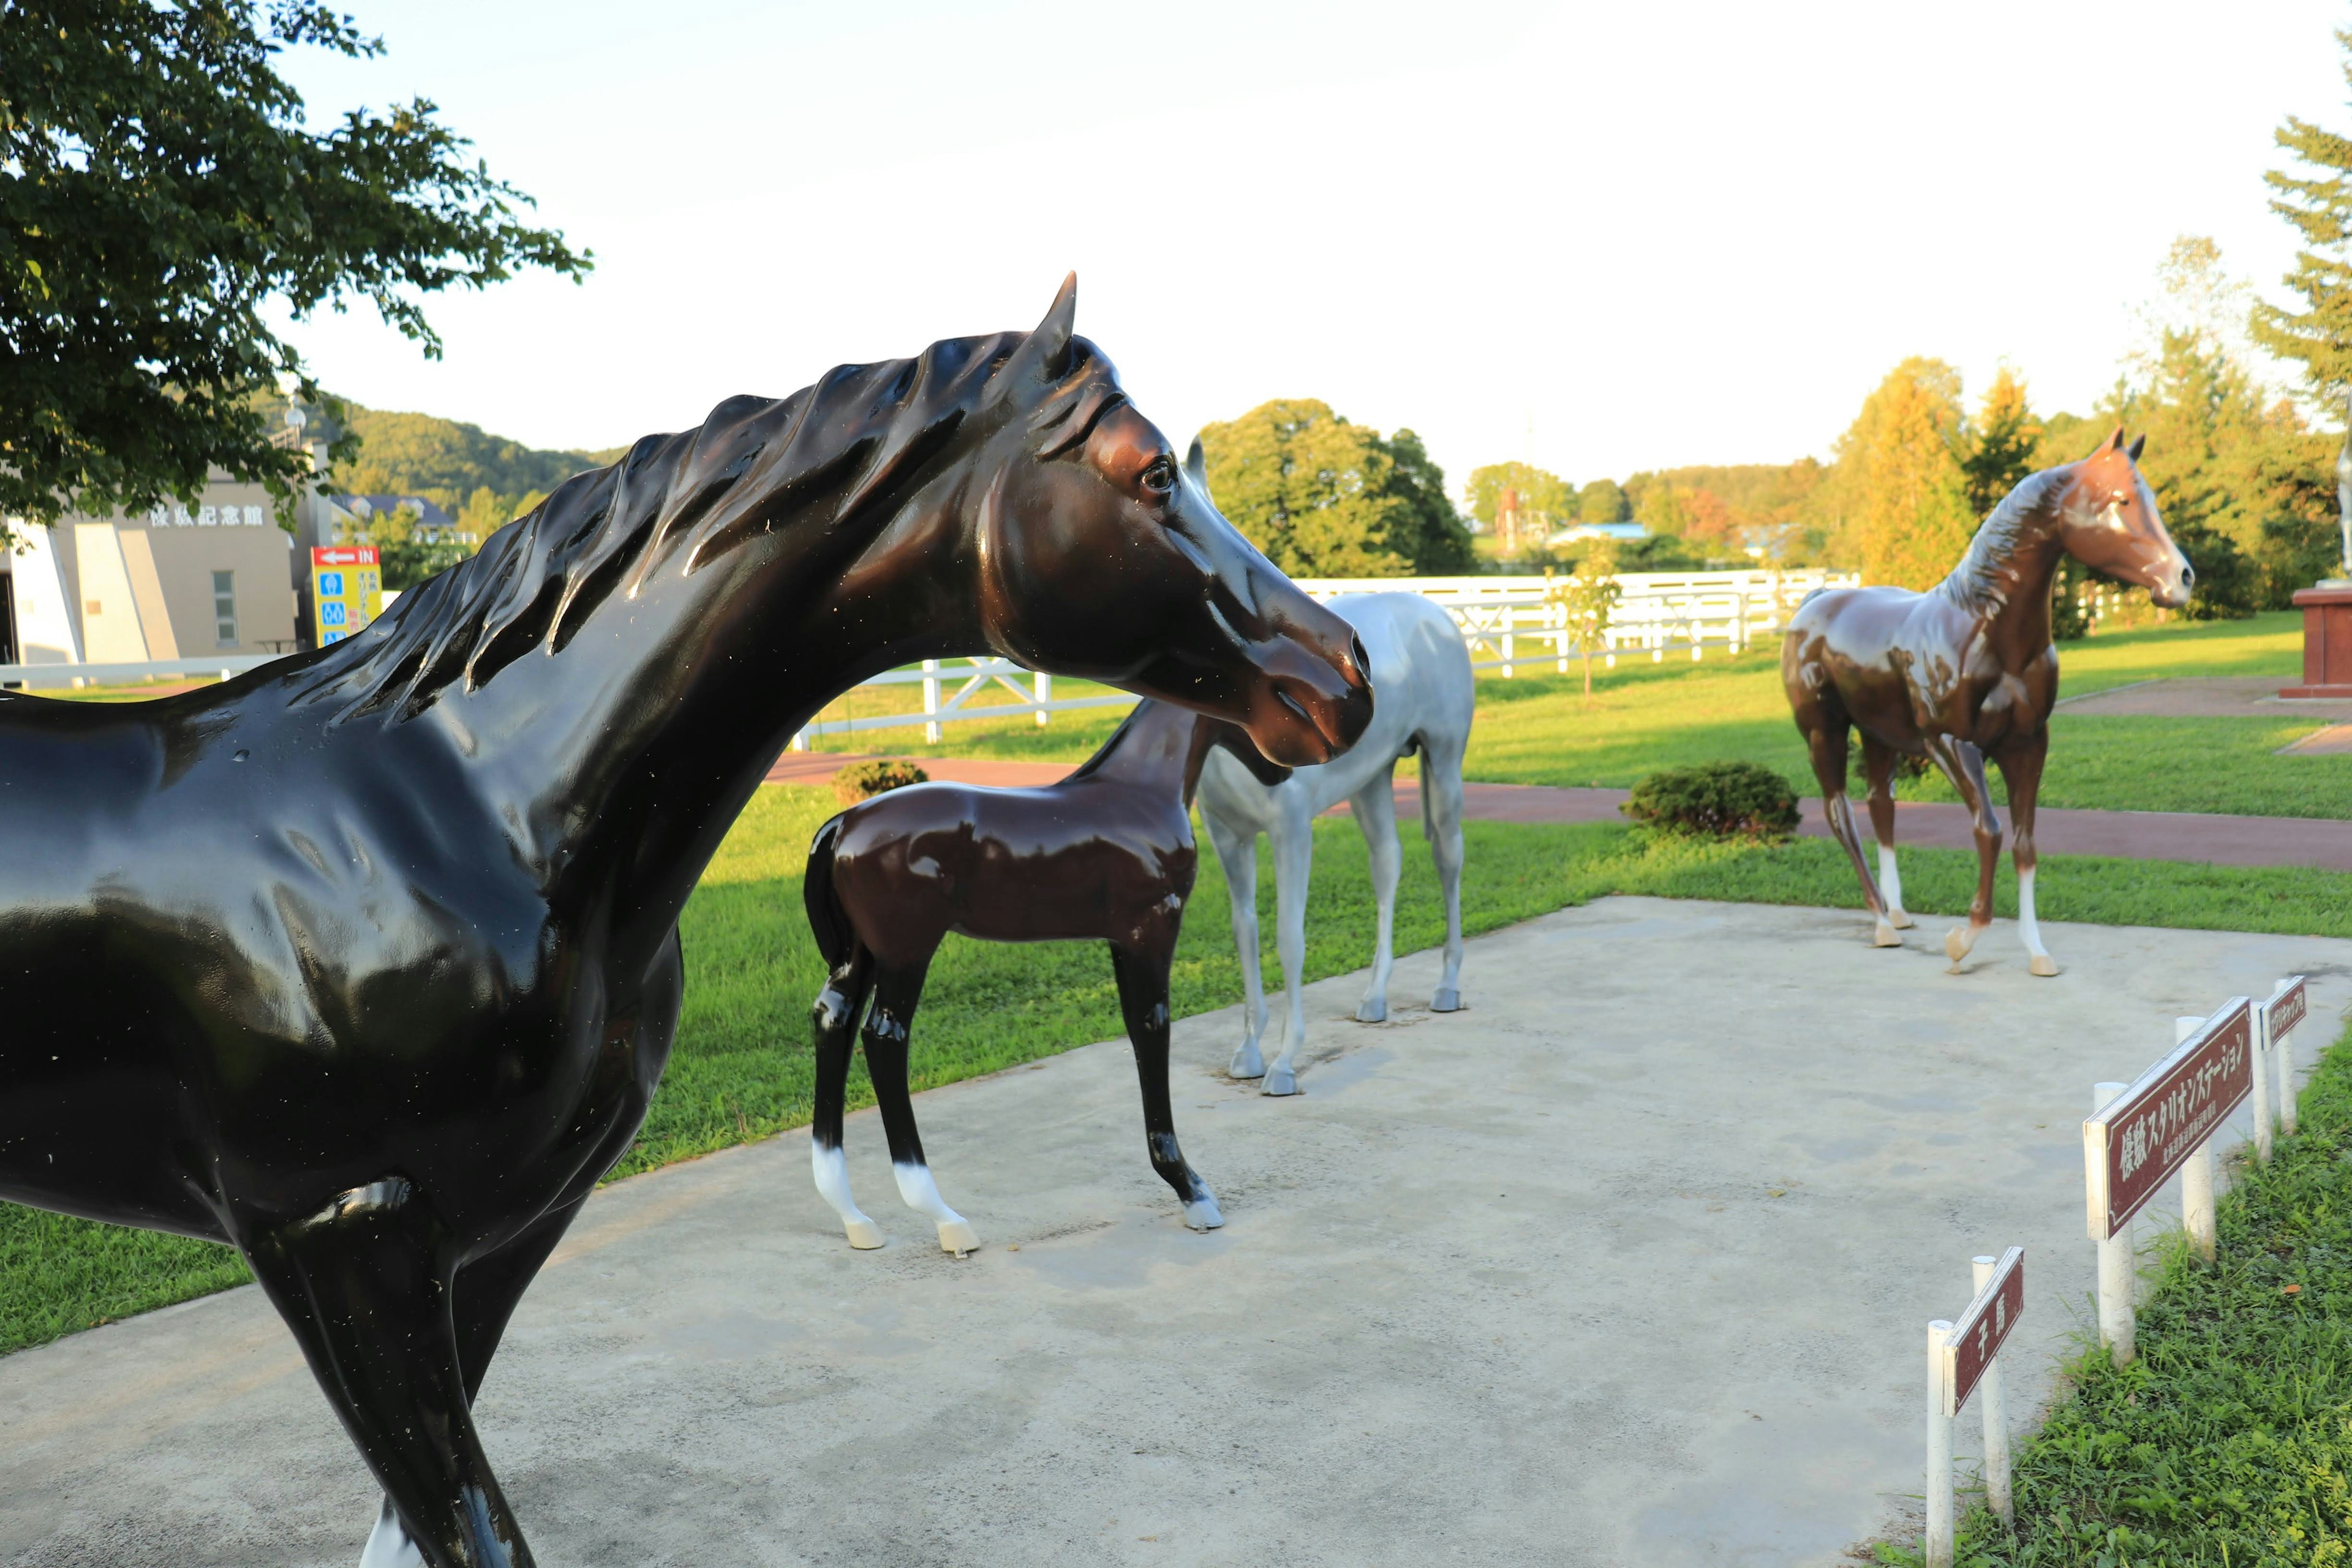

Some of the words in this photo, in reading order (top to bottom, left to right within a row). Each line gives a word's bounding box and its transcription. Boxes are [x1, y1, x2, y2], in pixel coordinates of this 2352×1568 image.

[358, 550, 374, 564] IN
[2119, 1033, 2244, 1182] 優駿スタリオンステーション
[1978, 1292, 2005, 1362] 子馬
